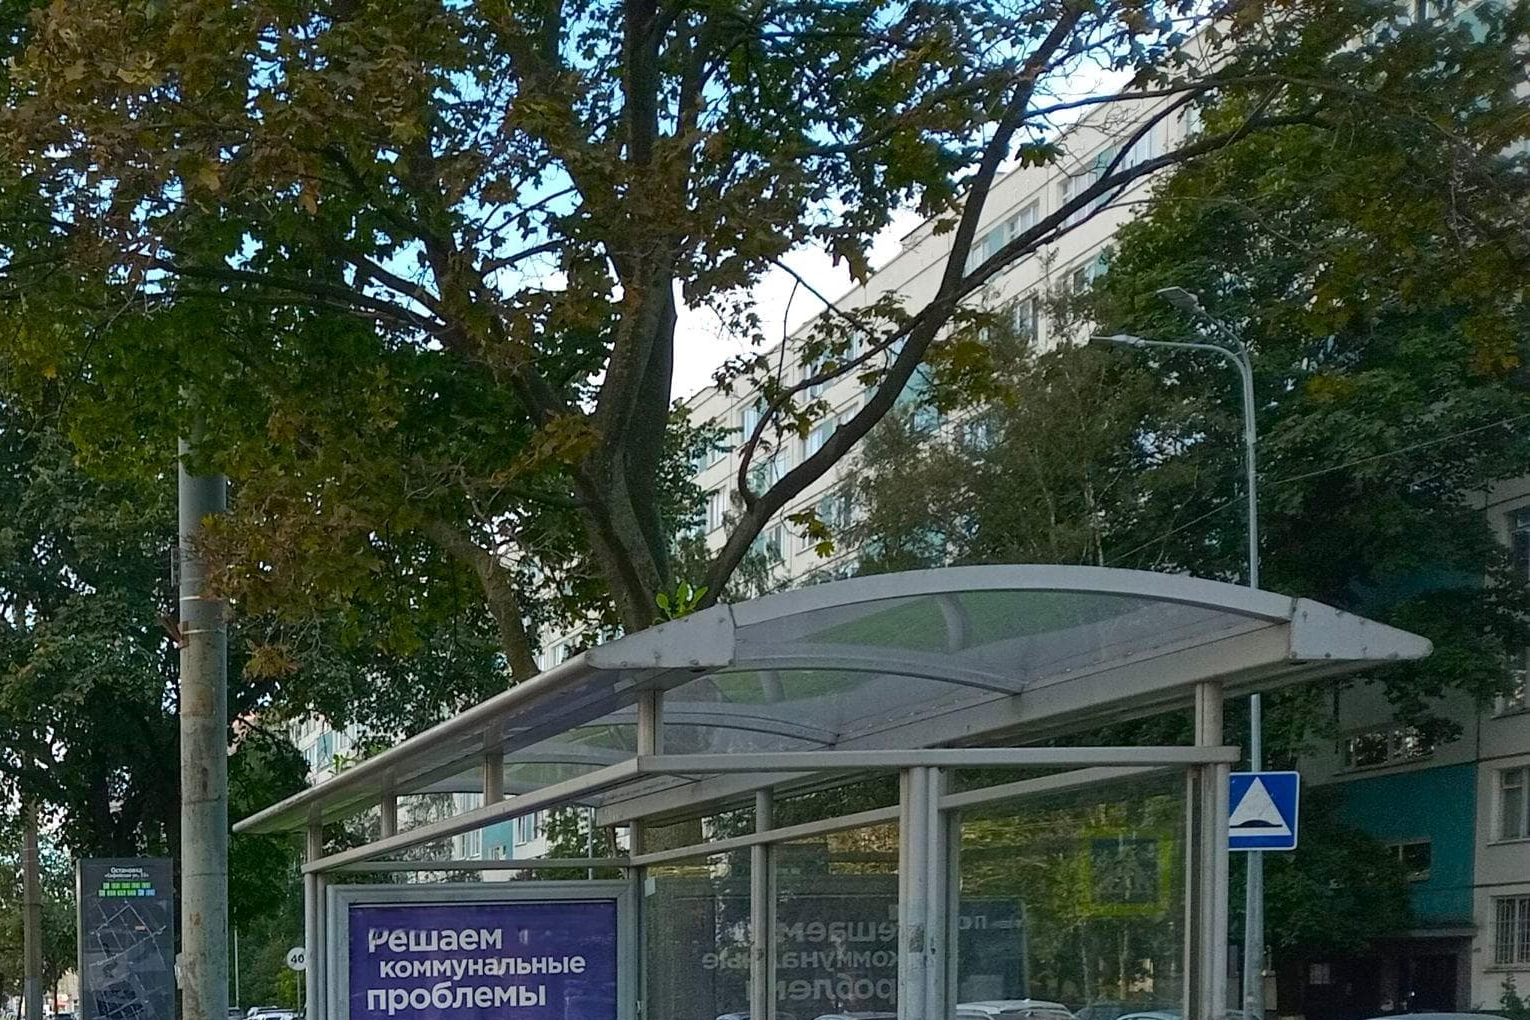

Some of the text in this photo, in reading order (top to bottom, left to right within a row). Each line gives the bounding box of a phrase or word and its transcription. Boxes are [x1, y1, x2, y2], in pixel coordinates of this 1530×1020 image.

[368, 928, 502, 953] Решаем
[290, 953, 305, 964] 40
[379, 955, 586, 981] коммунальные
[367, 981, 546, 1016] проблемы
